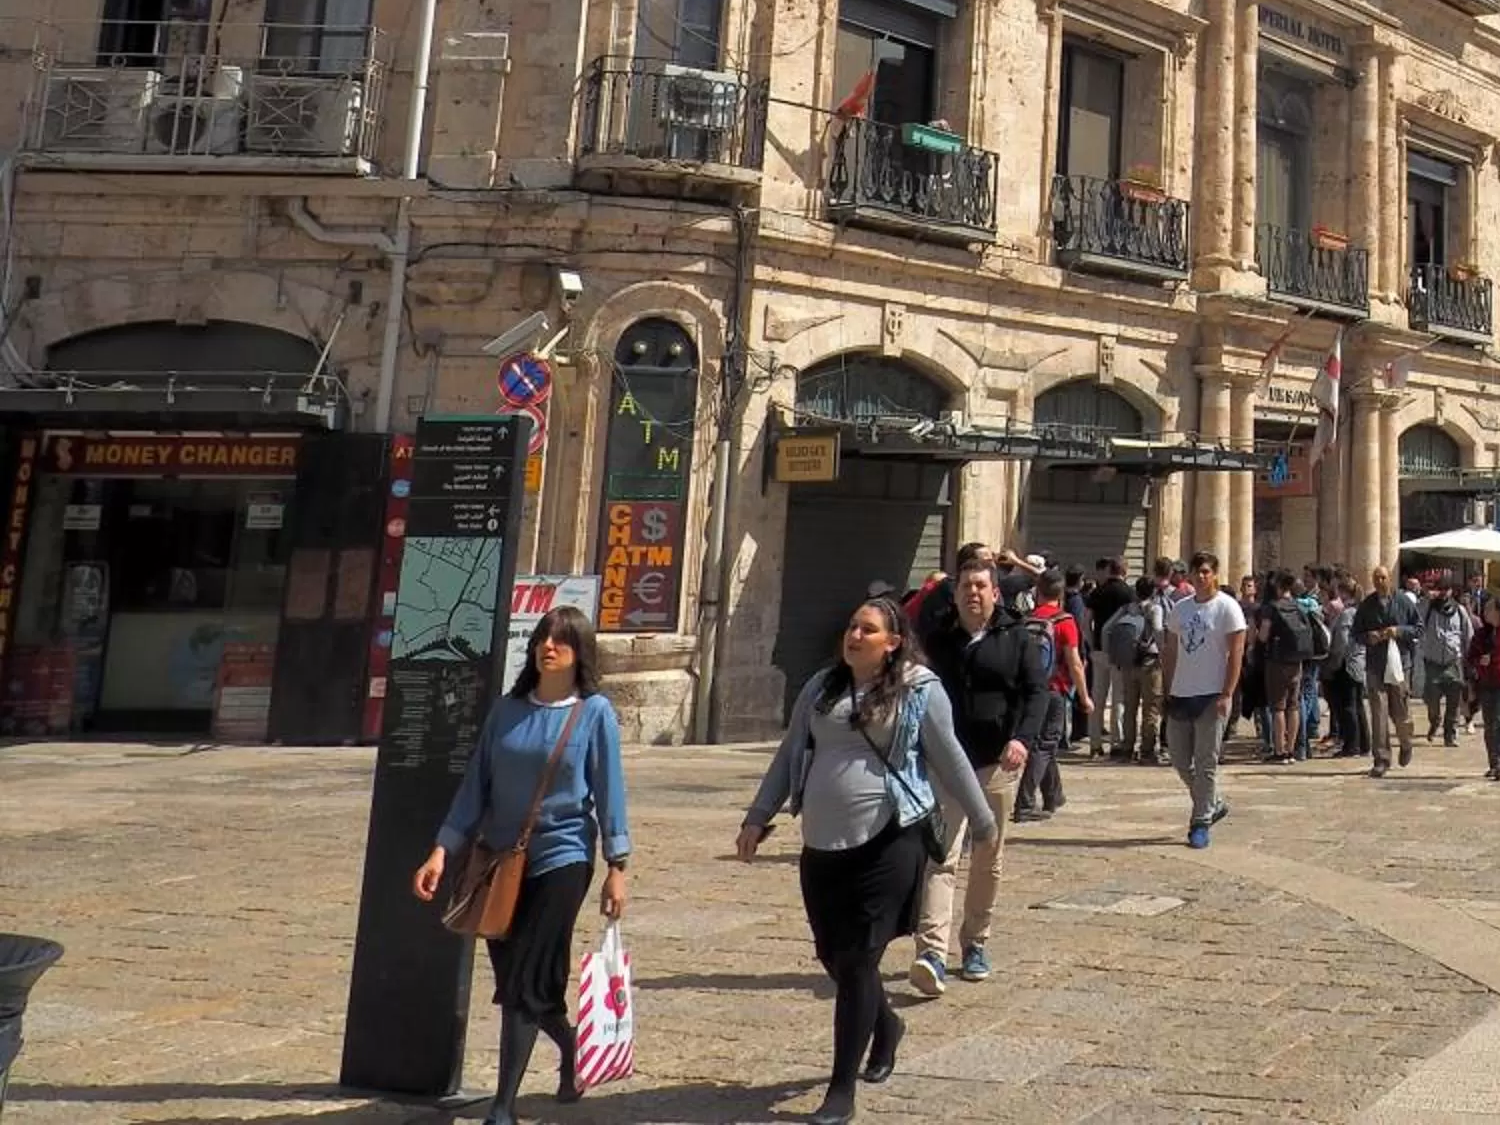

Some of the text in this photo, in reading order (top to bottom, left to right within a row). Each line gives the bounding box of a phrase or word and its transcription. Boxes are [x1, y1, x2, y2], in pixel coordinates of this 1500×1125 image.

[1261, 6, 1305, 40] PERIAL
[85, 443, 296, 466] MONEY CHANGER
[601, 504, 633, 629] CHANGE
[511, 583, 557, 614] TM
